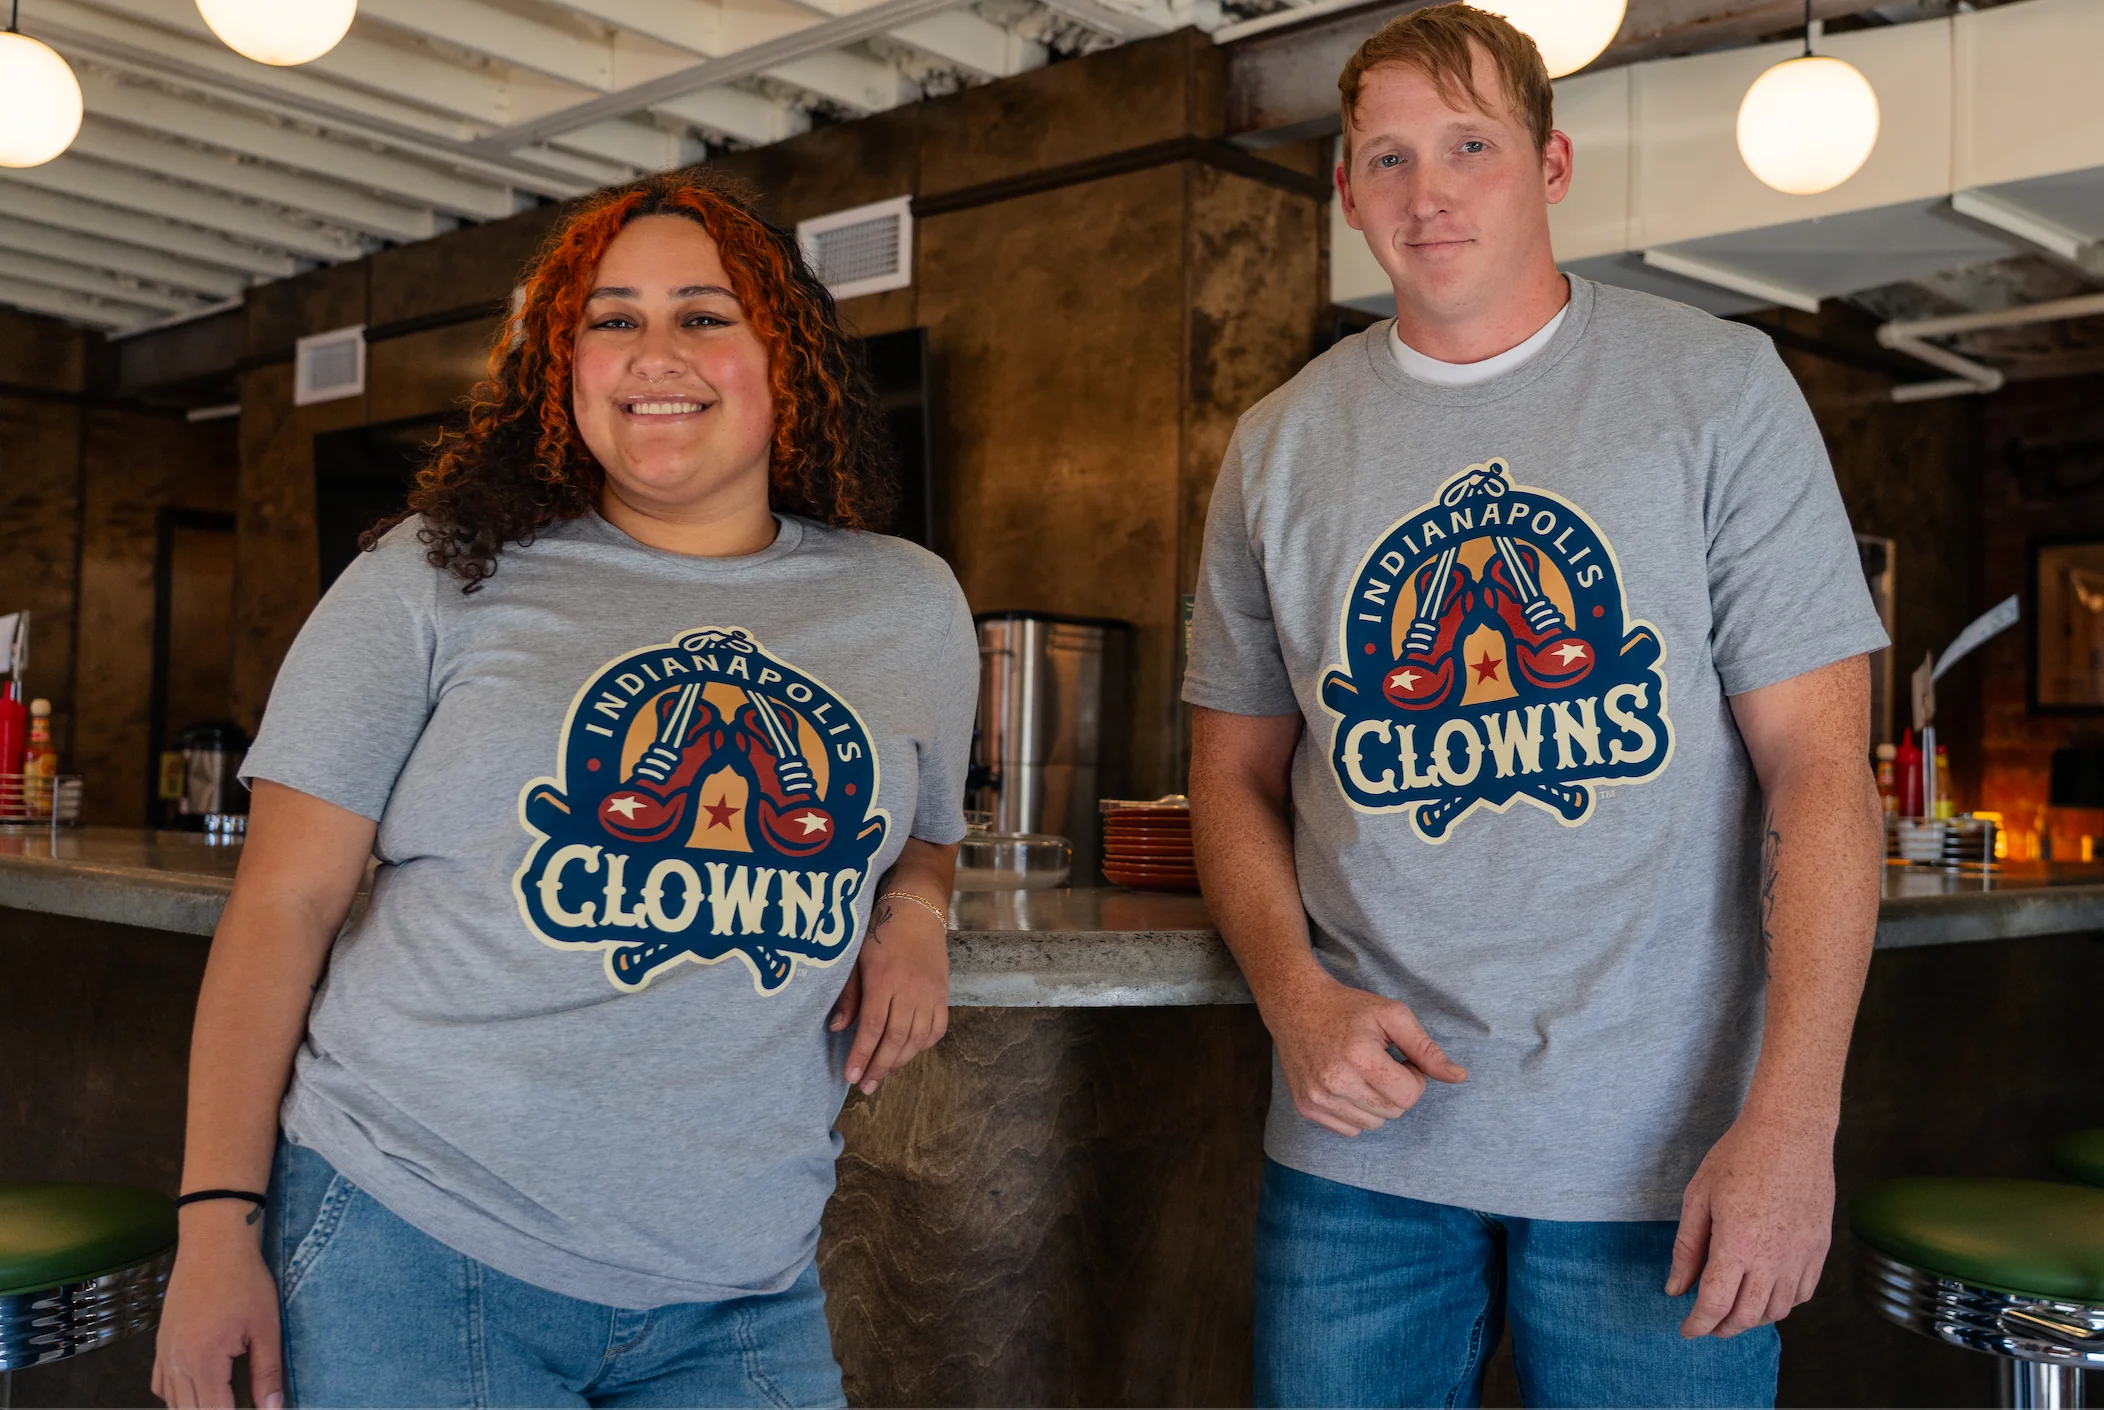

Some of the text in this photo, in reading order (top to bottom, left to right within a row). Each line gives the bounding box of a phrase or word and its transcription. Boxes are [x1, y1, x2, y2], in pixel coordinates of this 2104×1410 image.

[1359, 502, 1604, 623] INDIANAPOLIS
[585, 654, 862, 763] INDIANAPOLIS
[1341, 682, 1657, 794] CLOWNS
[536, 844, 862, 947] CLOWNS
